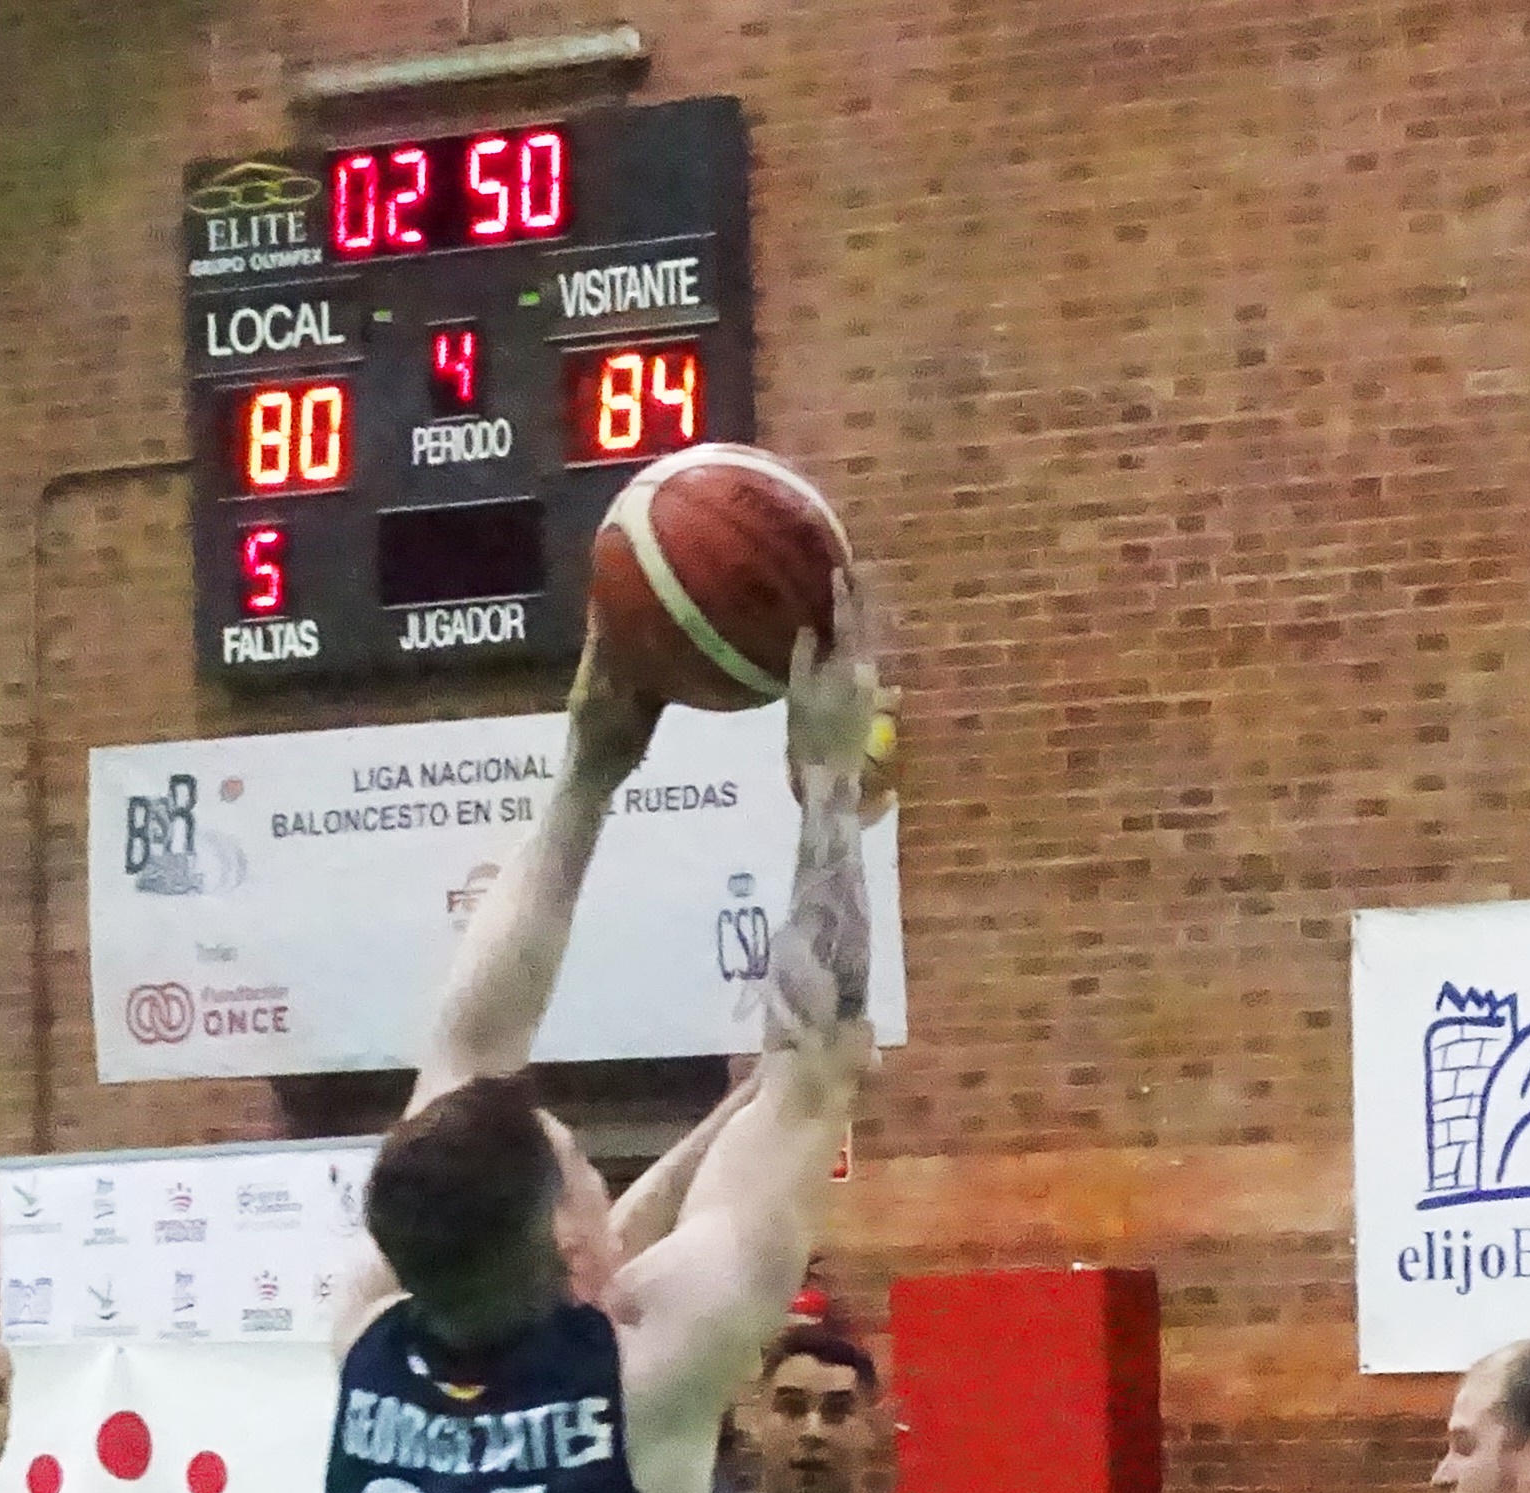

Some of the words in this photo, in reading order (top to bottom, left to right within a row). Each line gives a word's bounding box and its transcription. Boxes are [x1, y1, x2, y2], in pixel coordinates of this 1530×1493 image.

[333, 148, 428, 251] 02
[470, 132, 562, 236] 50
[207, 211, 308, 252] ELITE
[559, 257, 701, 318] VISITANTE
[206, 301, 345, 356] LOCAL
[432, 330, 474, 402] 4
[598, 353, 695, 450] 84
[248, 386, 343, 486] 80
[412, 419, 512, 466] PERIODO
[243, 530, 280, 608] 5
[223, 619, 320, 664] FALTAS
[399, 603, 526, 651] JUGADOR
[352, 765, 413, 794] LIGA
[420, 755, 554, 787] NACIONAL
[272, 802, 450, 839] BALONCESTO
[456, 799, 492, 826] EN
[624, 781, 739, 814] RUEDAS
[202, 1005, 291, 1036] ONCE
